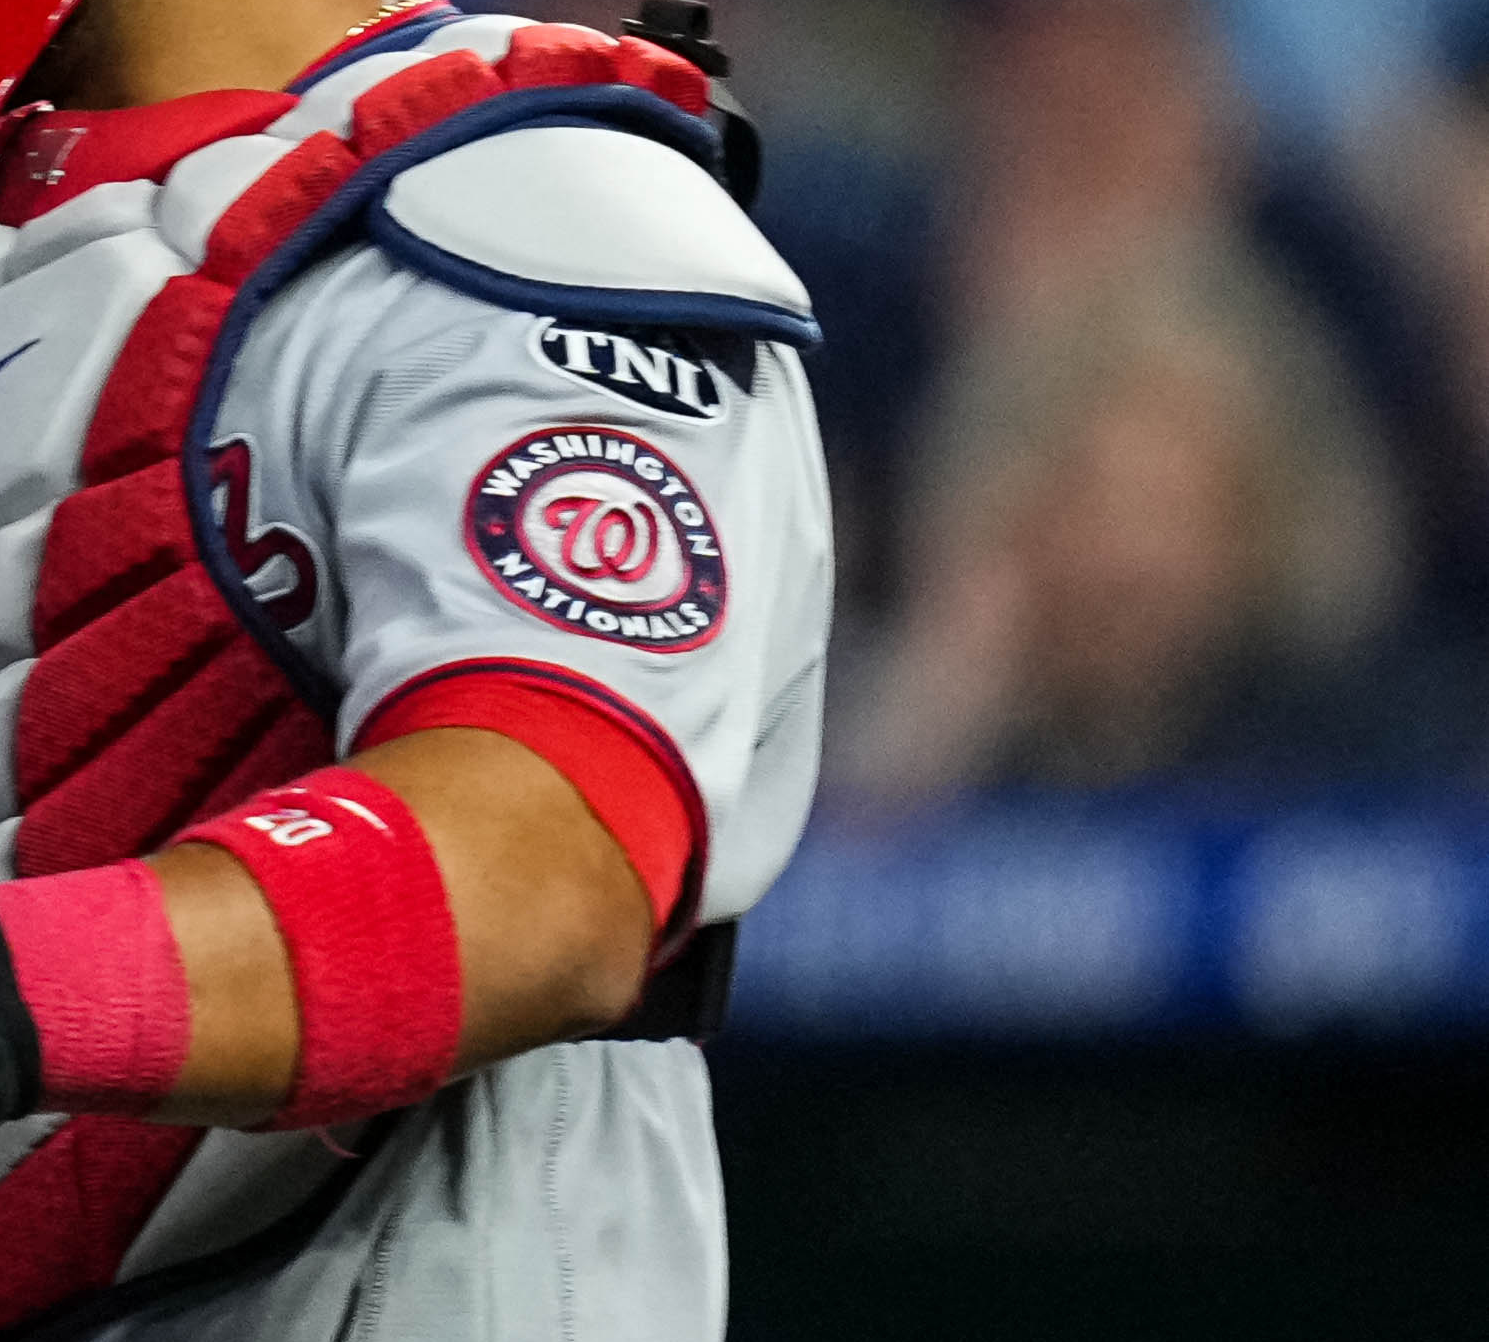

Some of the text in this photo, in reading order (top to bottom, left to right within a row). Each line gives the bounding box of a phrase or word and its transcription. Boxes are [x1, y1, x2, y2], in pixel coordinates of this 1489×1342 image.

[481, 434, 720, 557] WASHINGTON
[543, 495, 659, 584] W
[493, 552, 710, 640] NATIONALS
